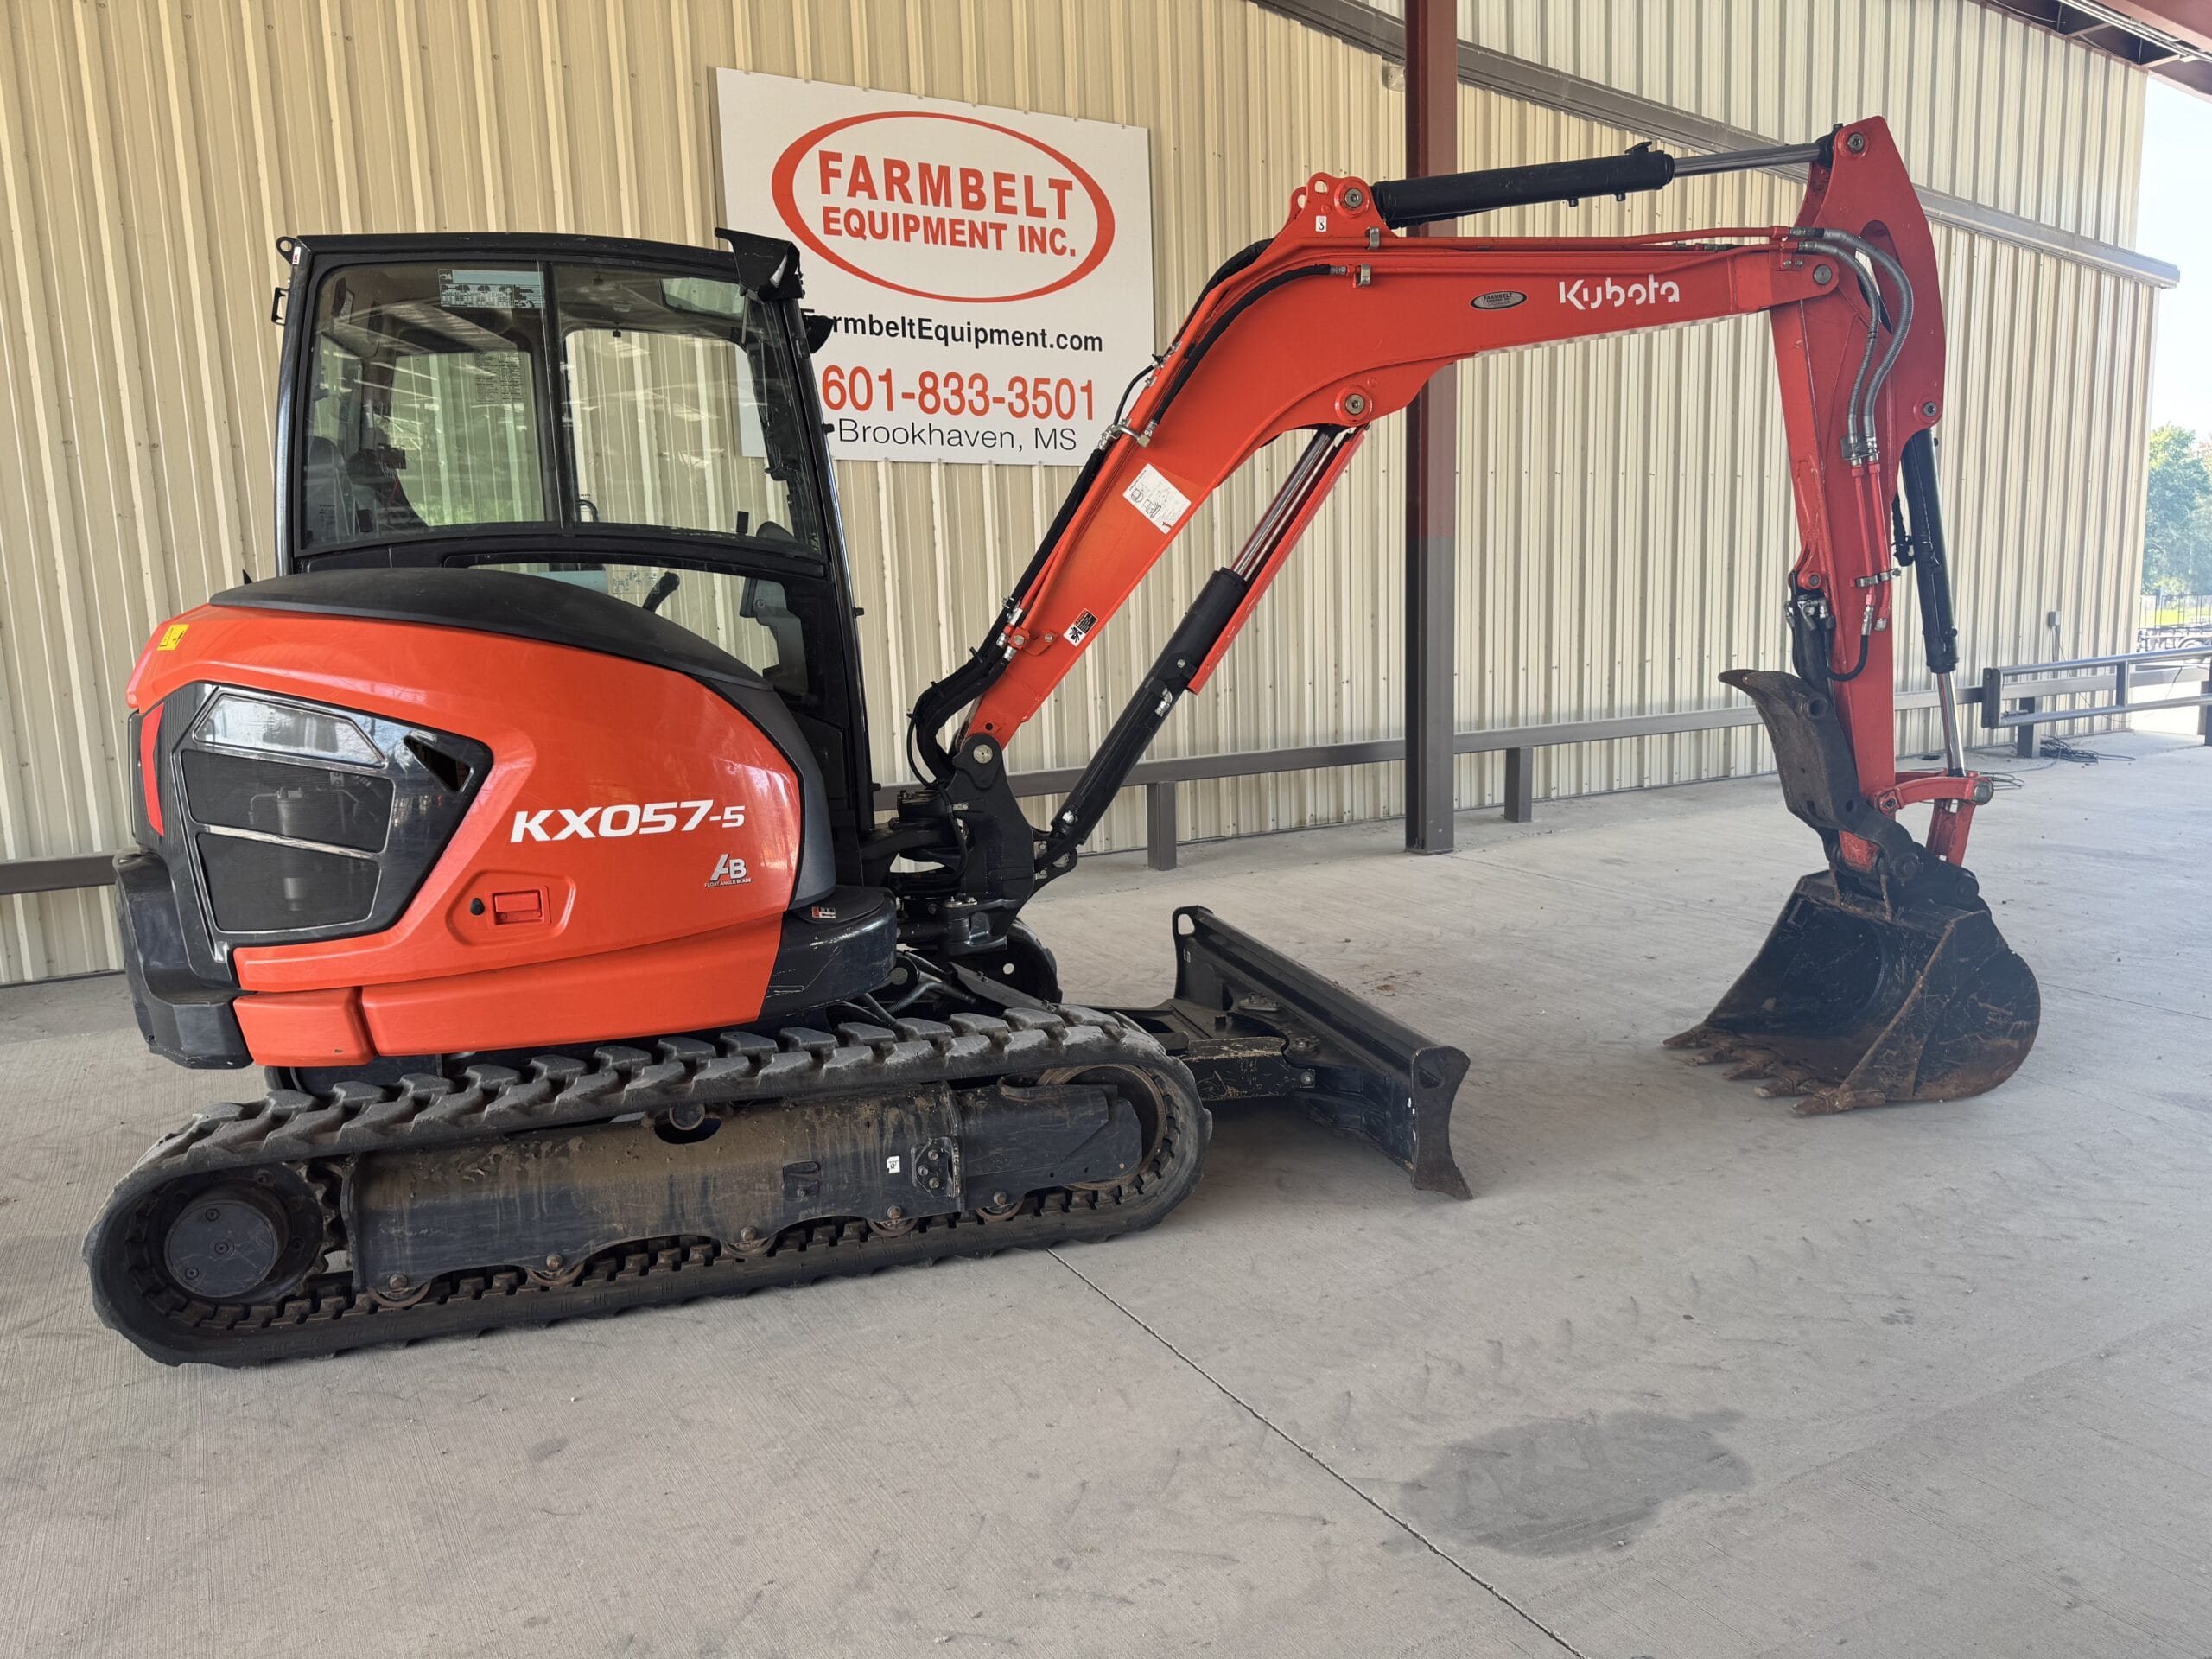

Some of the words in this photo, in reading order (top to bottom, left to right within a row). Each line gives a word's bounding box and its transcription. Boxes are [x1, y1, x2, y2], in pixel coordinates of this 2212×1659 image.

[818, 149, 1073, 221] FARMBELT
[822, 206, 1007, 251] EQUIPMENT
[1018, 224, 1077, 257] INC.
[1558, 273, 1681, 311] Kubota
[800, 308, 1103, 353] rmbeltEquipment.com
[821, 364, 1095, 422] 601-833-3501
[838, 417, 1022, 452] Brookhaven,
[1034, 427, 1077, 451] MS
[510, 799, 746, 843] KX057-5
